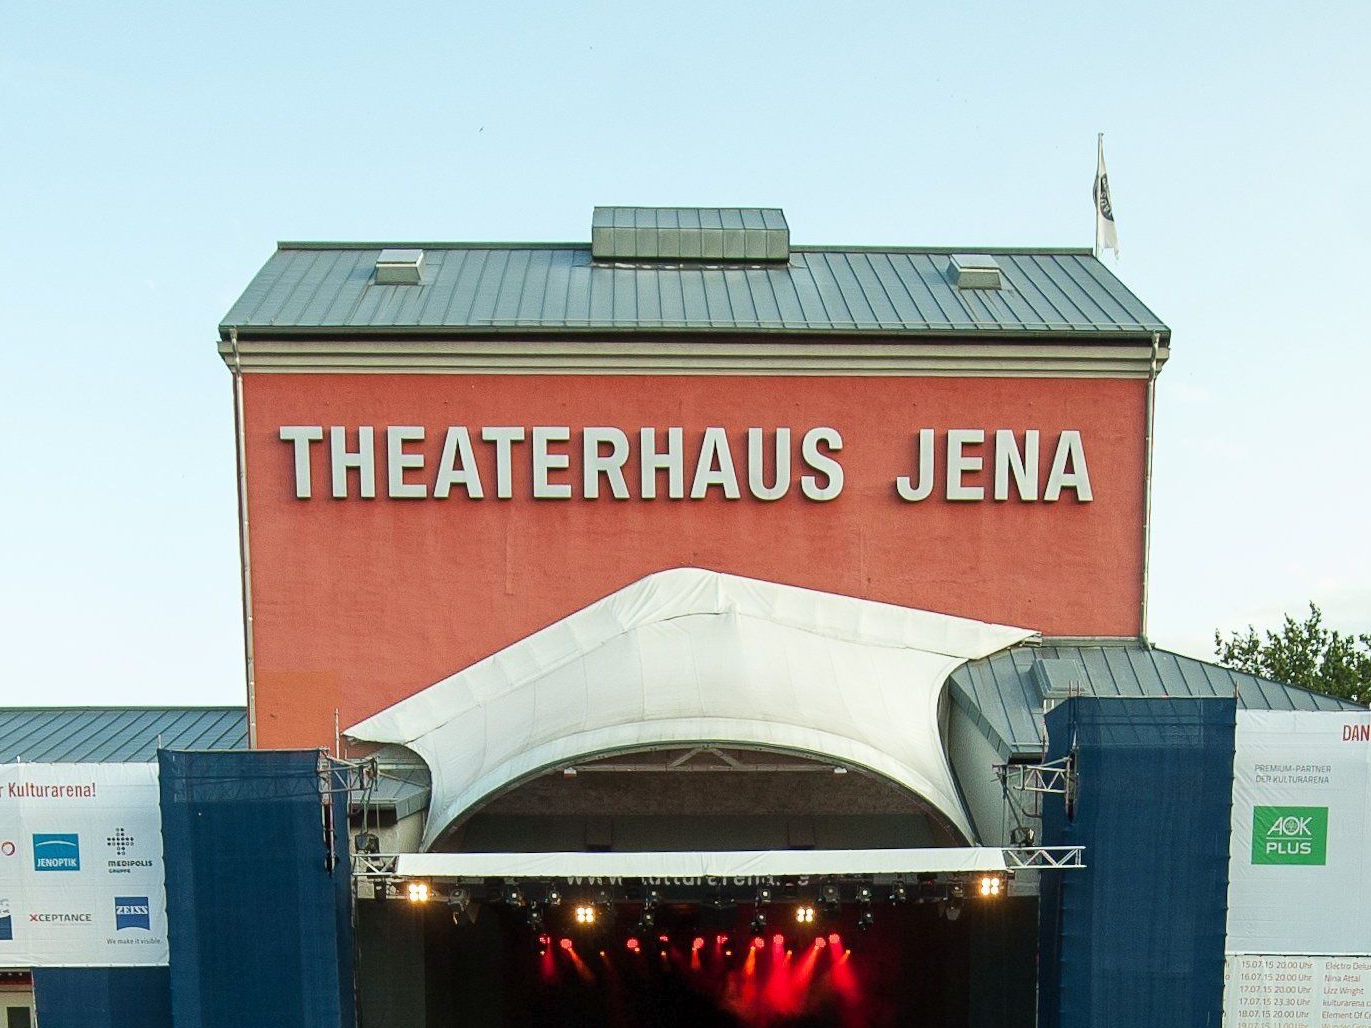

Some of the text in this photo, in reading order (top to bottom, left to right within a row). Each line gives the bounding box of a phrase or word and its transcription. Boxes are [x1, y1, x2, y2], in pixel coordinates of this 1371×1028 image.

[279, 425, 1094, 503] THEATERHAUS JENA
[1254, 764, 1332, 773] PREMIUM-PARTNER
[1255, 775, 1329, 784] DER KULTURARENA
[8, 781, 96, 798] Kulturarena!
[1267, 816, 1313, 836] AOK
[1266, 842, 1312, 854] PLUS
[37, 858, 77, 867] JENOPTIK
[116, 906, 149, 915] ZEISS
[29, 914, 92, 922] XCEPTANCE
[1242, 961, 1274, 969] 15.07.15
[1276, 961, 1298, 969] 20.00
[1241, 973, 1273, 981] 16.07.15
[1240, 986, 1272, 994] 17.07.15
[1274, 986, 1296, 994] 20.00
[1298, 986, 1312, 994] Uhr
[1339, 987, 1364, 996] Wright
[1239, 998, 1271, 1006] 17.07.15
[1274, 998, 1295, 1006] 23.30
[1297, 998, 1310, 1006] Uhr
[1238, 1010, 1271, 1018] 18.07.15
[1273, 1010, 1295, 1018] 20.00
[1296, 1010, 1309, 1018] Uhr
[1321, 1011, 1352, 1019] Element
